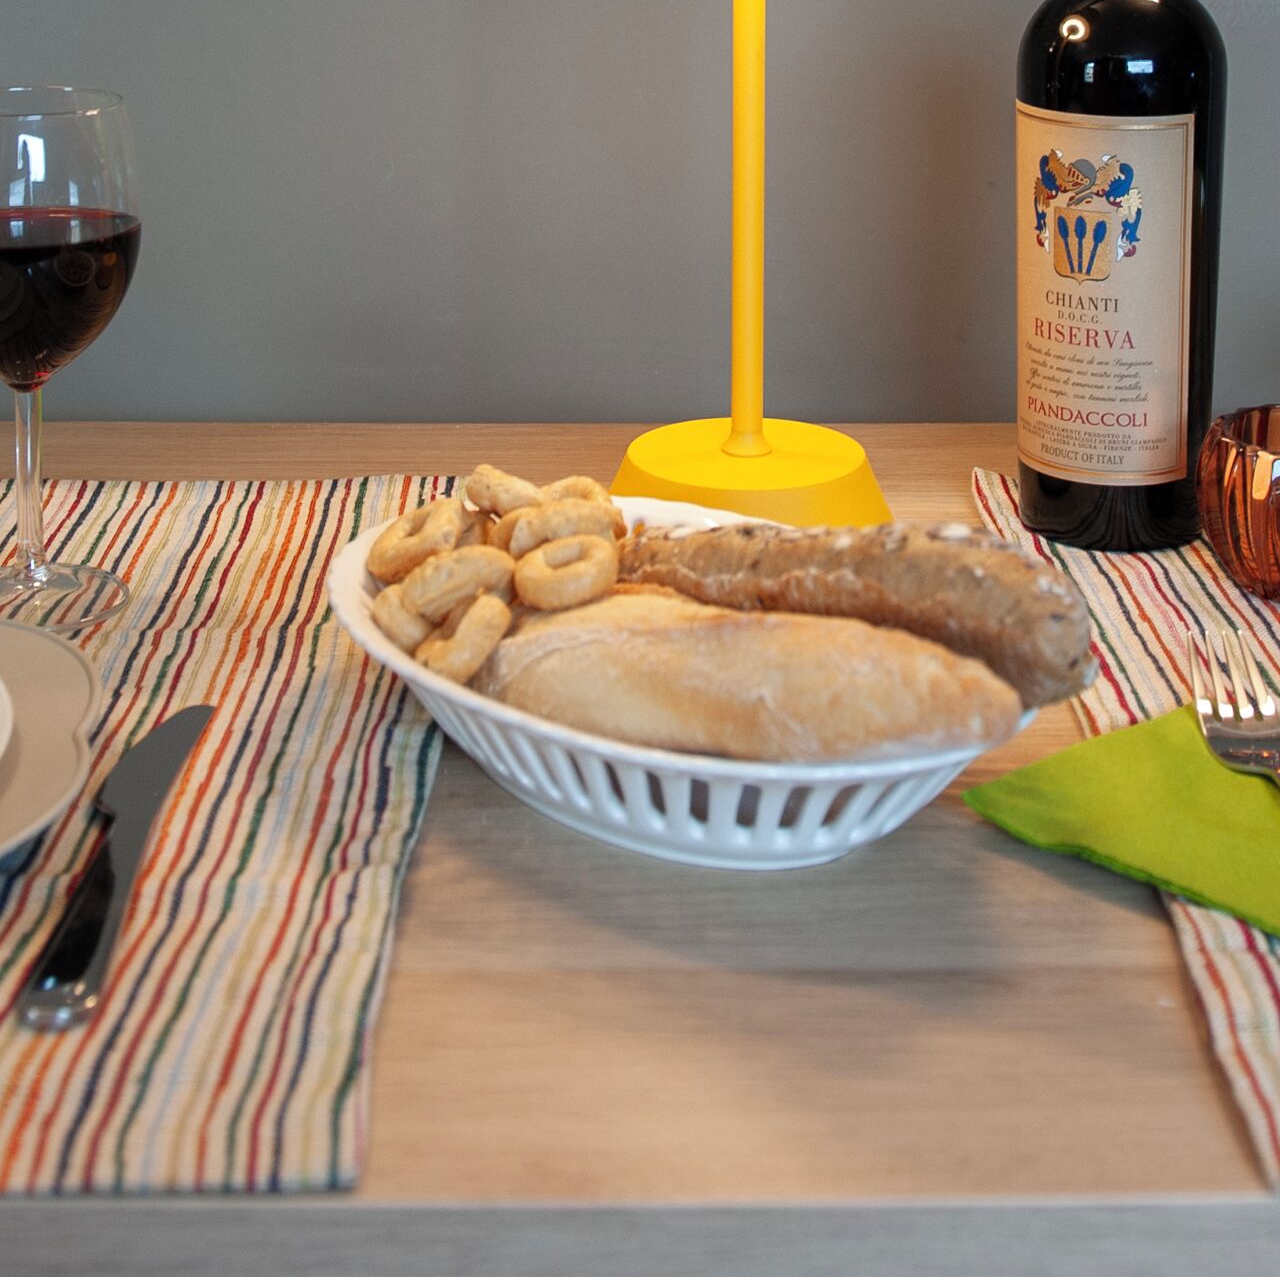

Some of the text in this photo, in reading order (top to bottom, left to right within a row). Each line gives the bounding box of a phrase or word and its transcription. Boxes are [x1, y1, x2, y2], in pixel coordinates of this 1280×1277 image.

[1045, 290, 1120, 313] CHIANTI
[1057, 310, 1103, 324] D.O.C.G.
[1034, 317, 1136, 349] RISERVA
[1027, 395, 1148, 428] PIANDACCOLI
[1084, 431, 1120, 440] PRODOTTO
[1041, 442, 1125, 465] PRODUCT OF ITALY
